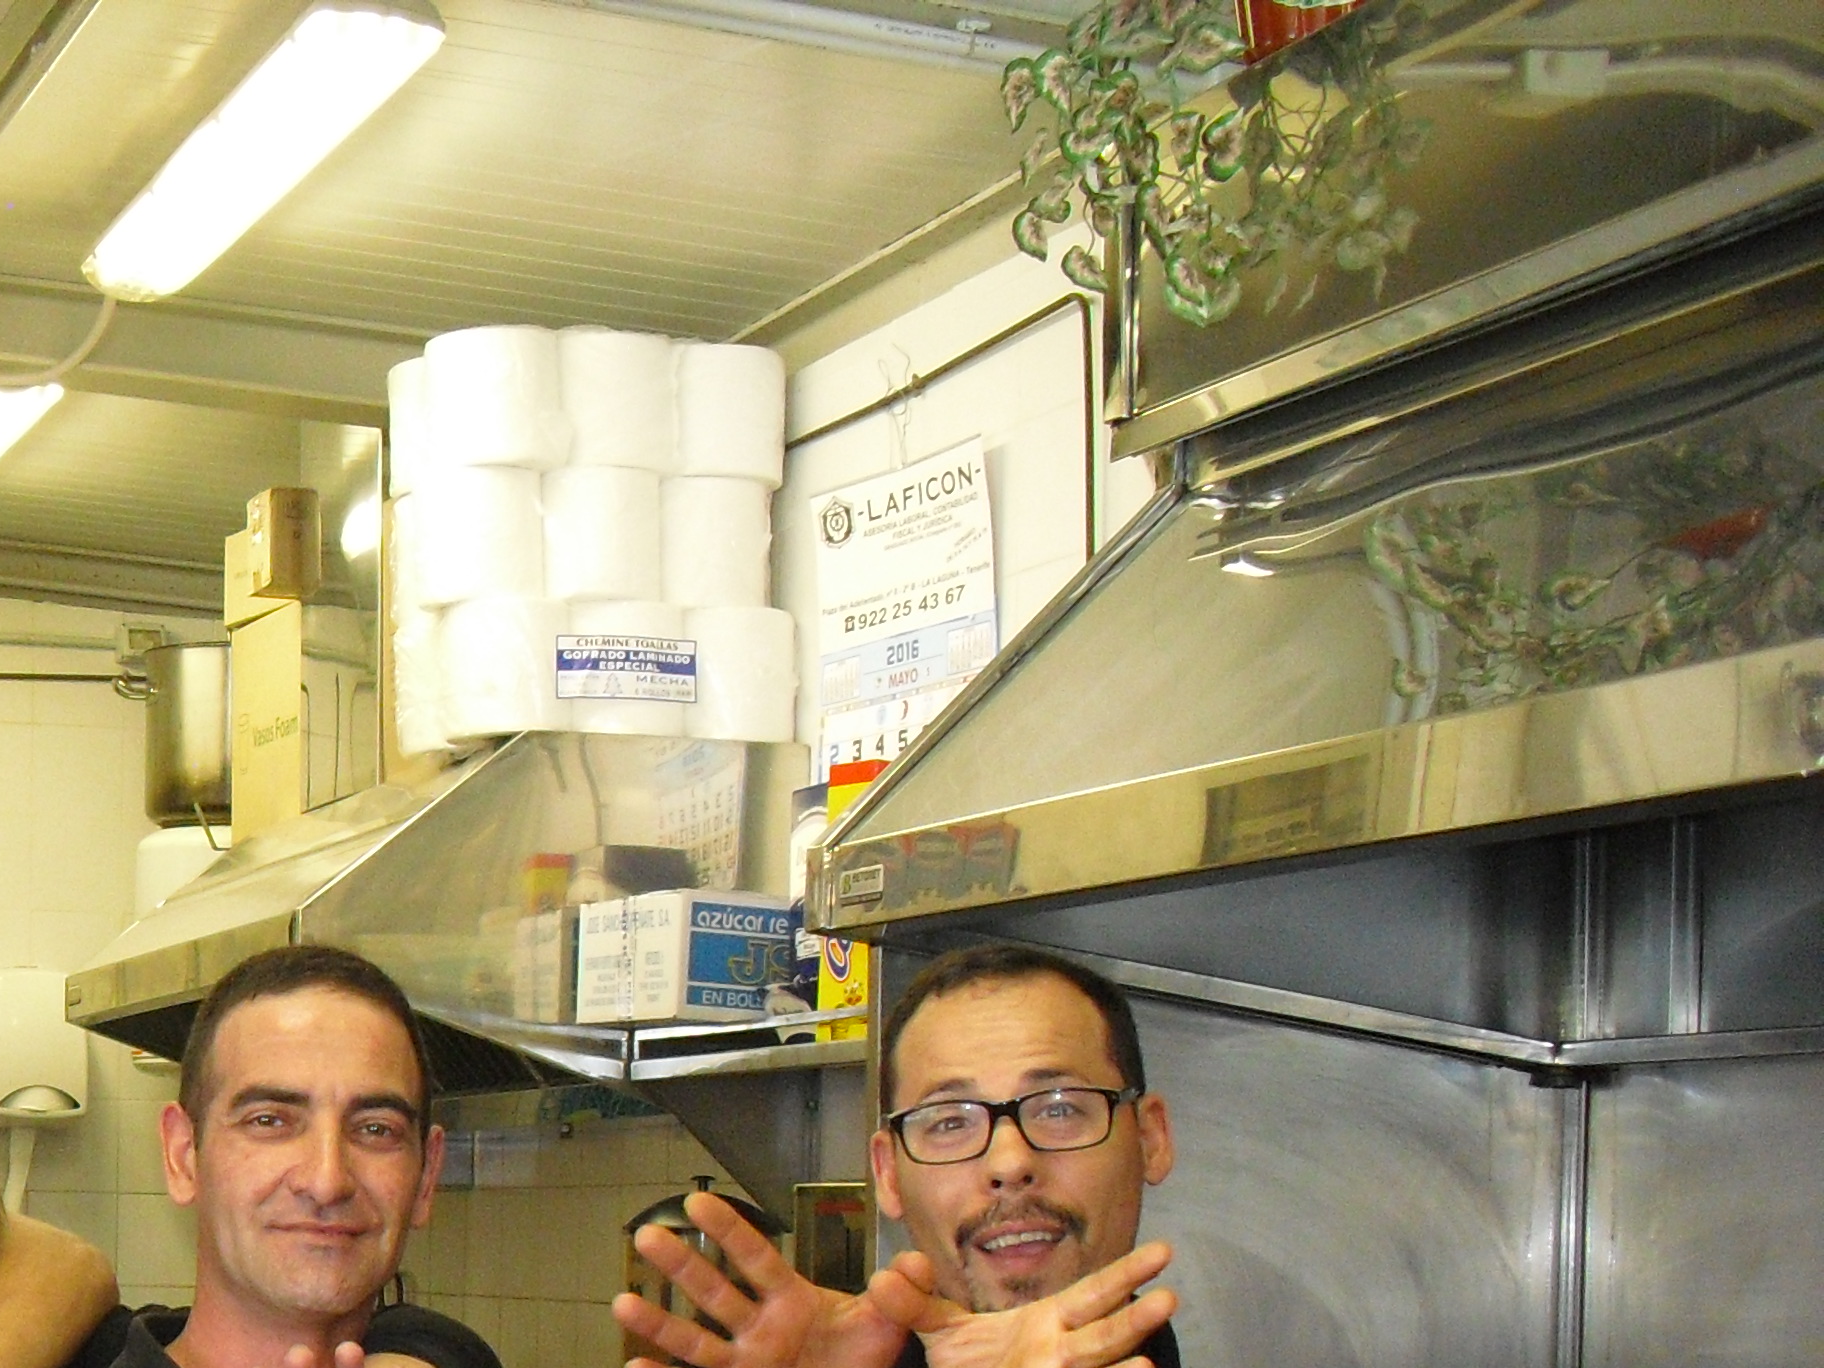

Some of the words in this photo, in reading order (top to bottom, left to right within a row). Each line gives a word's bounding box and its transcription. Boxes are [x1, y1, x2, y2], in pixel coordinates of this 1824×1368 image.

[858, 607, 887, 629] 922
[892, 599, 912, 620] 25
[919, 592, 939, 611] 43
[945, 584, 966, 605] 67
[886, 639, 919, 666] 2016
[636, 674, 689, 687] MECHA
[888, 667, 919, 689] MAYO
[853, 739, 862, 762] 3
[876, 734, 884, 756] 4
[898, 729, 909, 751] 5
[697, 907, 763, 932] azúcar
[702, 990, 724, 1006] EN
